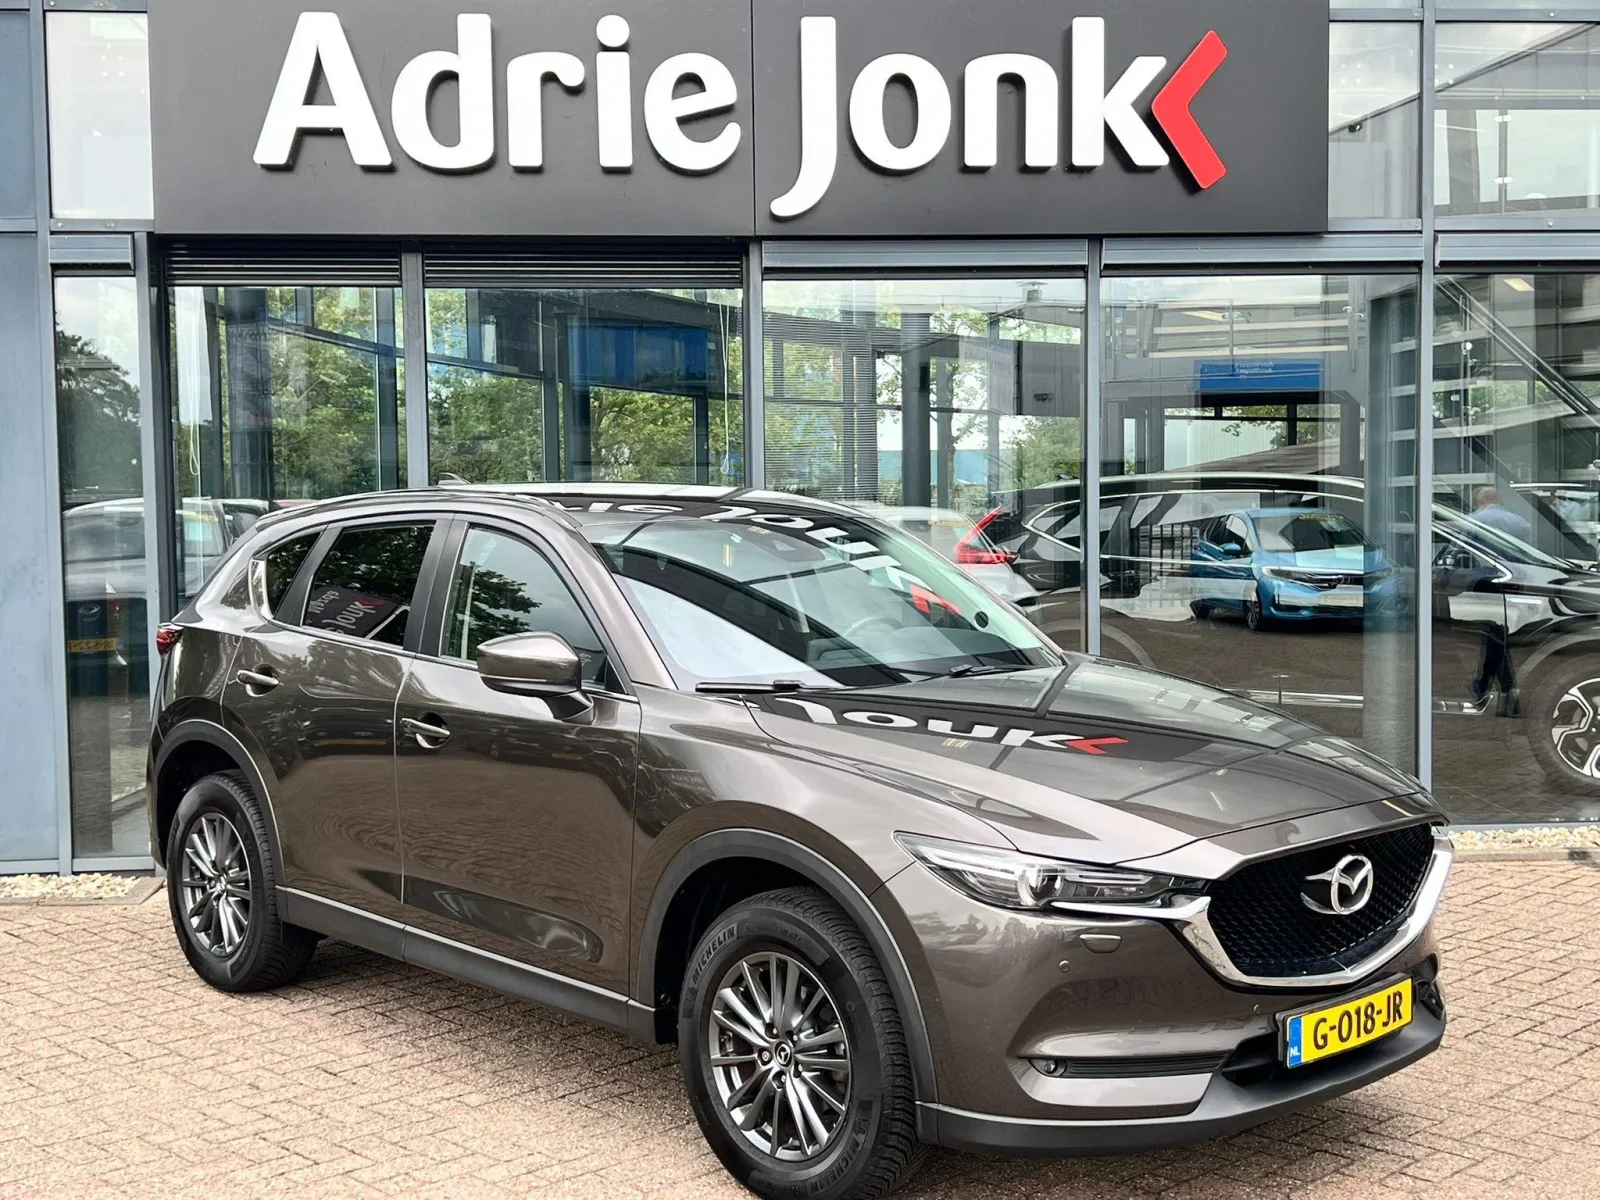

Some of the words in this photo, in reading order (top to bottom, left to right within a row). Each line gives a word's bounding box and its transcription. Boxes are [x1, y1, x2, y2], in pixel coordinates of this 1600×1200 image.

[253, 11, 742, 172] Adrie
[770, 15, 1171, 219] Jonk
[692, 926, 736, 985] MICHELIN
[1313, 990, 1403, 1050] G-018-JR
[1290, 1046, 1301, 1058] NL
